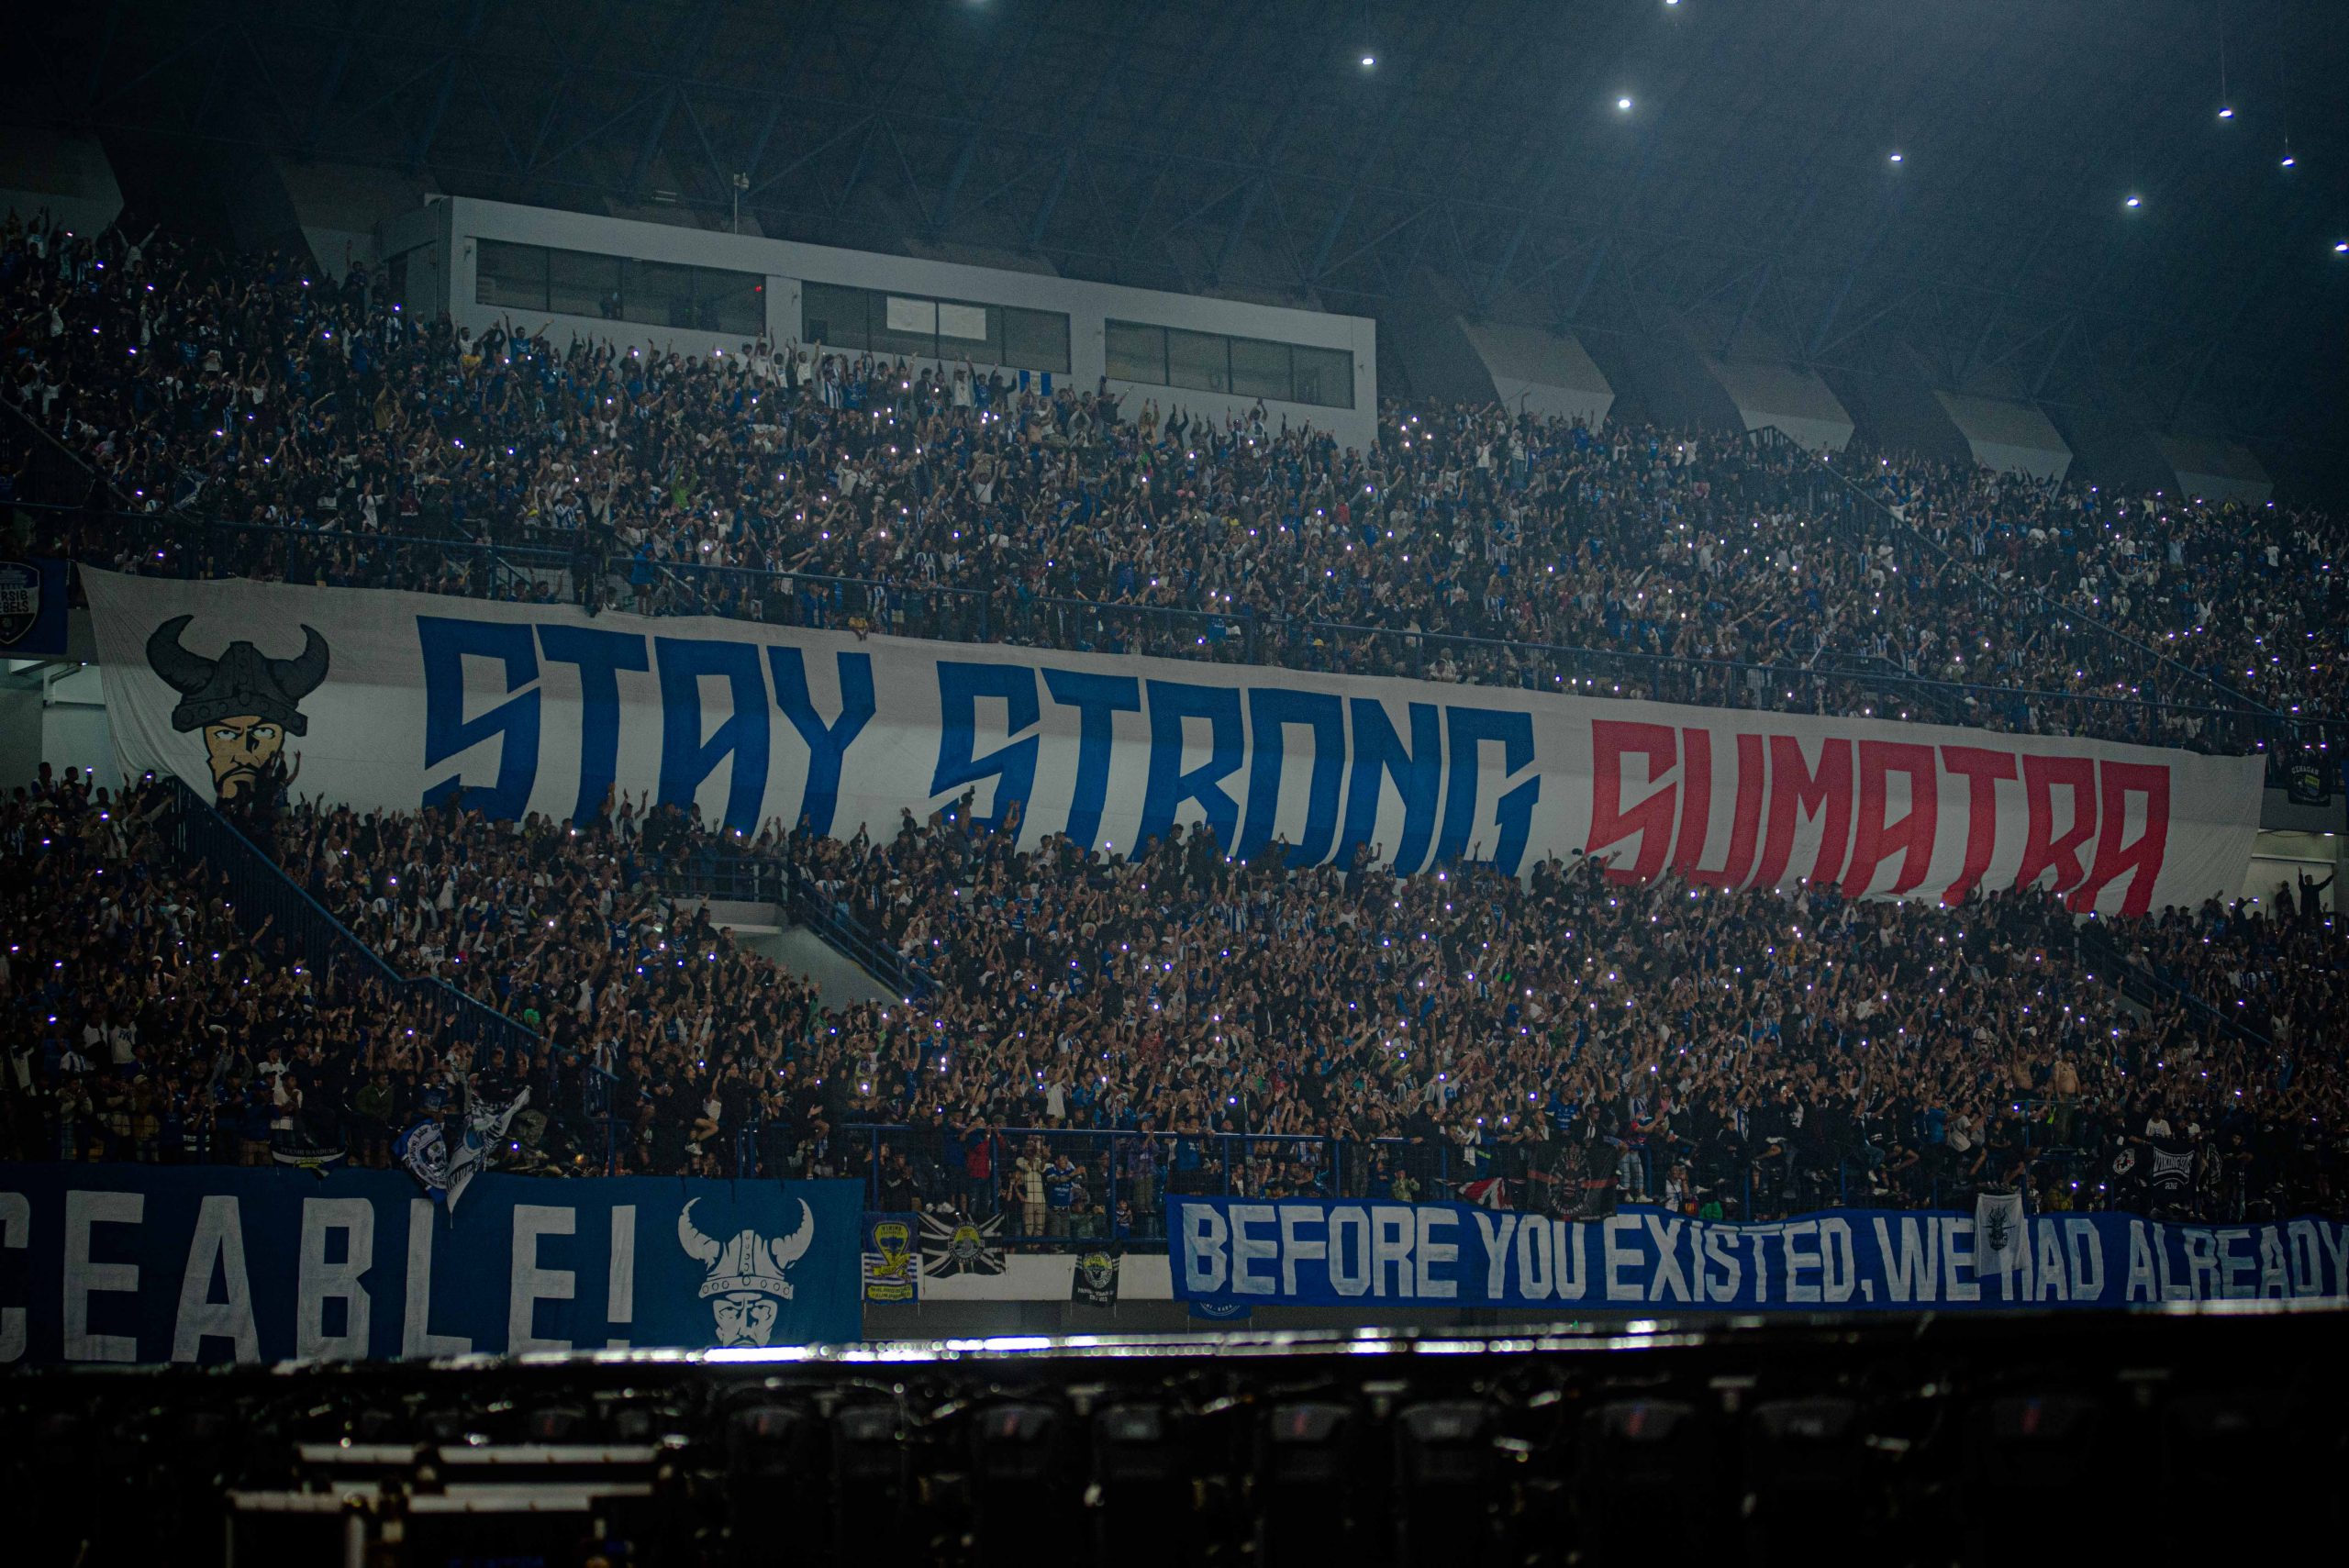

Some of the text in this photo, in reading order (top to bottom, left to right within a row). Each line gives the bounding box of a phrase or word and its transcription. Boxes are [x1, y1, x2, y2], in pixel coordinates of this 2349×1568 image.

[0, 600, 29, 613] BELS
[416, 615, 2170, 916] STAY STRONG SUMATRA
[1182, 1203, 1459, 1298] BEFORE
[1472, 1211, 1586, 1300] YOU
[1873, 1217, 1981, 1302] WE
[2125, 1218, 2349, 1301] ALREADY
